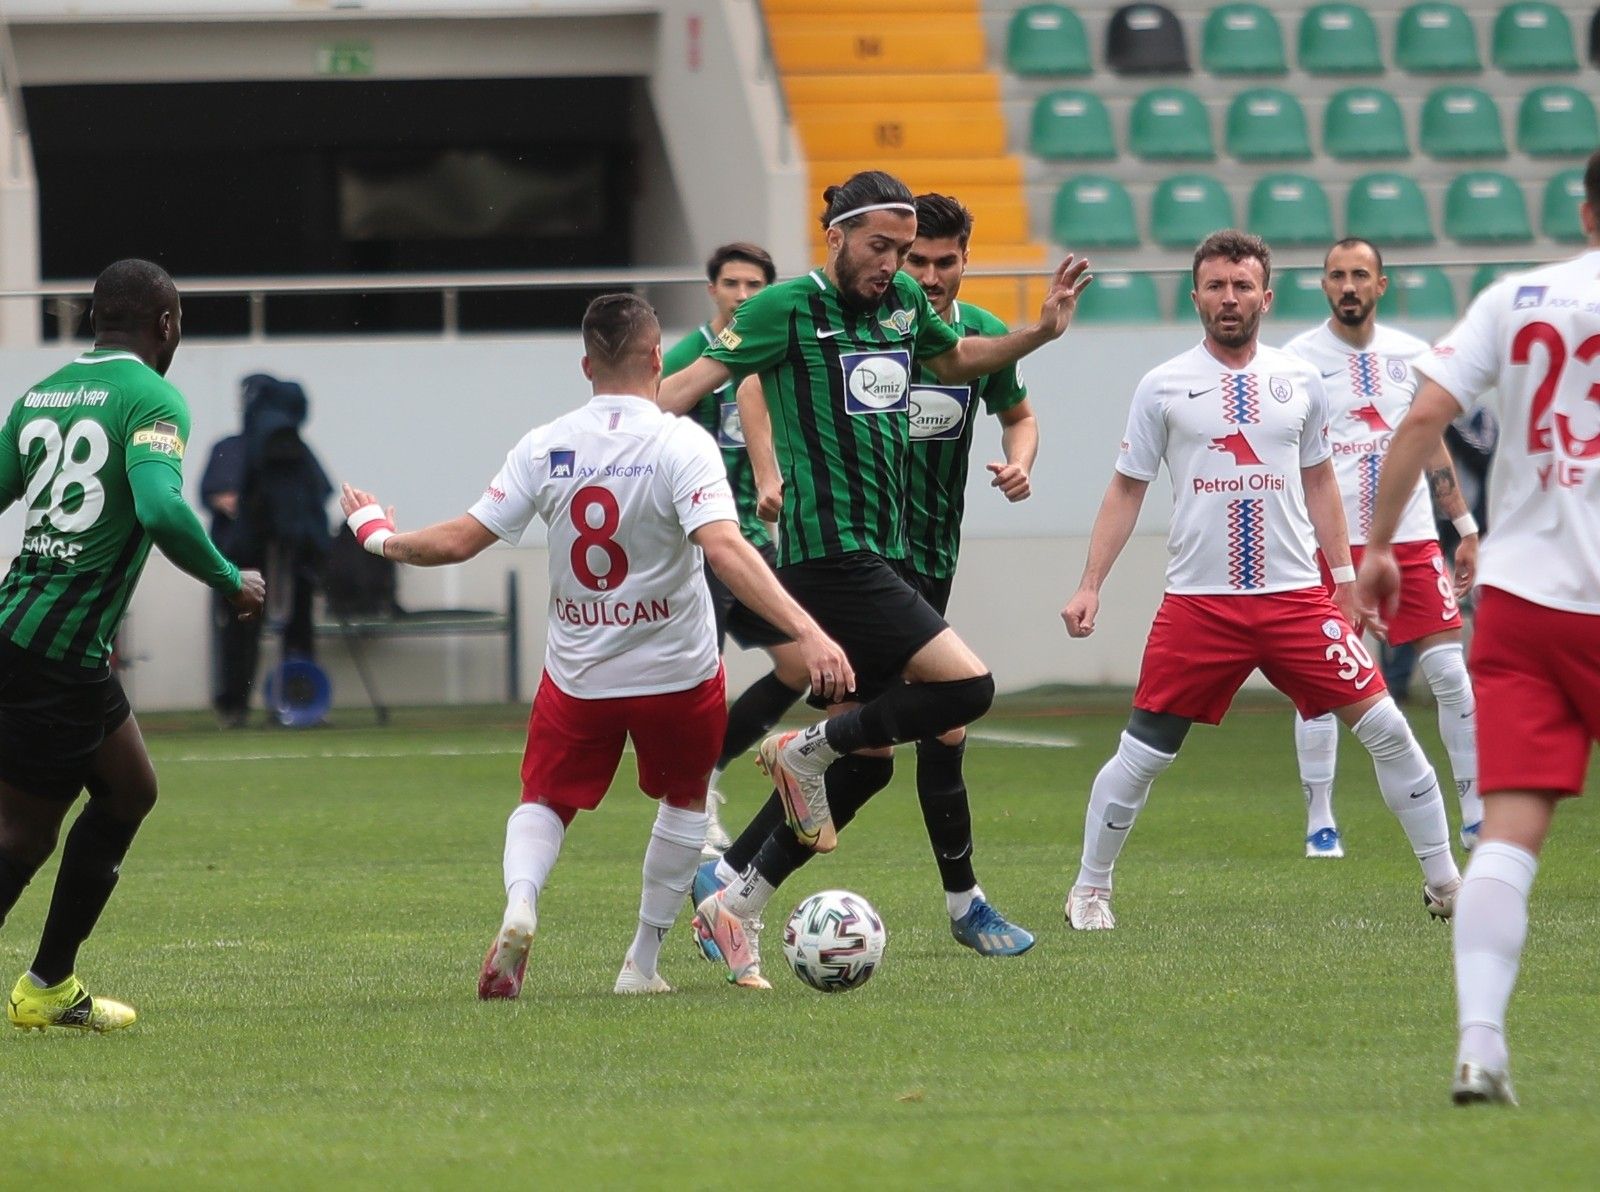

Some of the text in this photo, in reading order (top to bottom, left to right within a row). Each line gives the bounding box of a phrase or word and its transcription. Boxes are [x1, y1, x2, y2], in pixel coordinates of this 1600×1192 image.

[856, 368, 901, 397] Ramiz
[1332, 439, 1377, 456] Petrol
[19, 419, 109, 532] 28
[551, 464, 571, 477] AXA
[1193, 473, 1285, 495] Petrol Ofisi
[570, 485, 629, 592] 8
[1437, 575, 1455, 610] 9
[556, 598, 670, 627] OĞULCAN
[1325, 633, 1374, 681] 30
